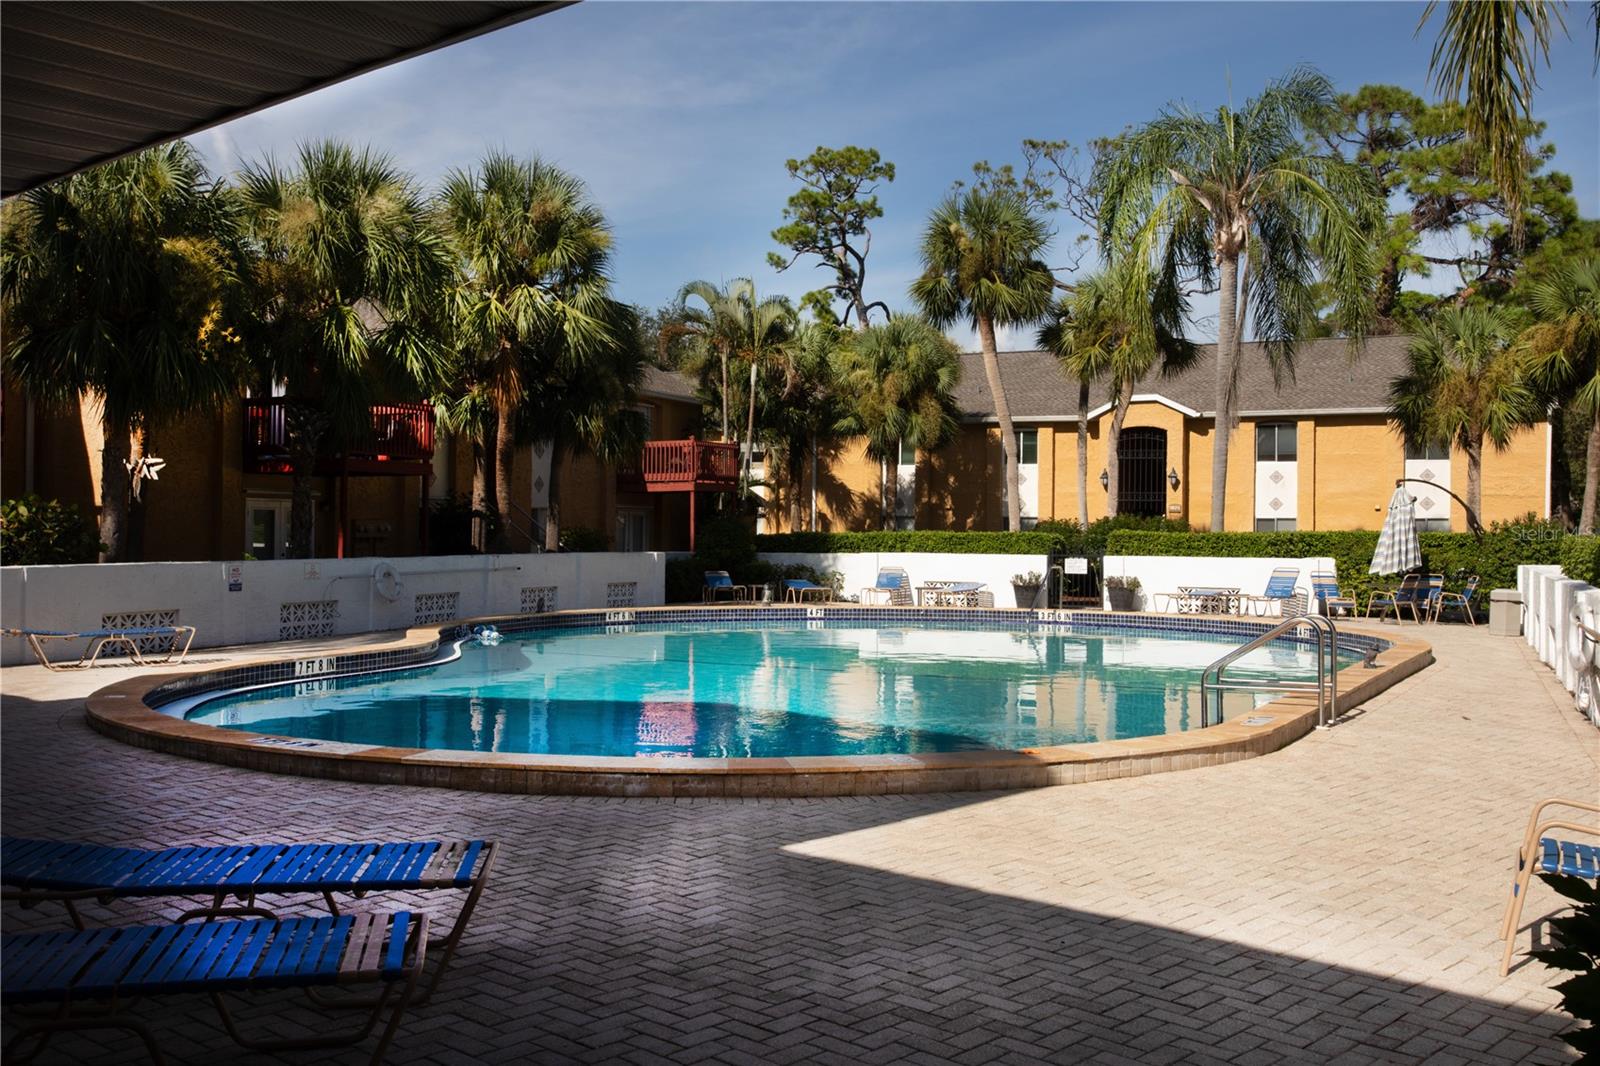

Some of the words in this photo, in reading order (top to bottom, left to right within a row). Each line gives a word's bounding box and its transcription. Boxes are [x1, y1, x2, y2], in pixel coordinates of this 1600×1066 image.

[1047, 612, 1056, 620] FT
[1057, 612, 1063, 621] 6
[1063, 613, 1071, 621] IN
[298, 661, 303, 675] 7
[305, 660, 316, 674] FT
[318, 659, 324, 672] 8
[326, 657, 335, 671] IN
